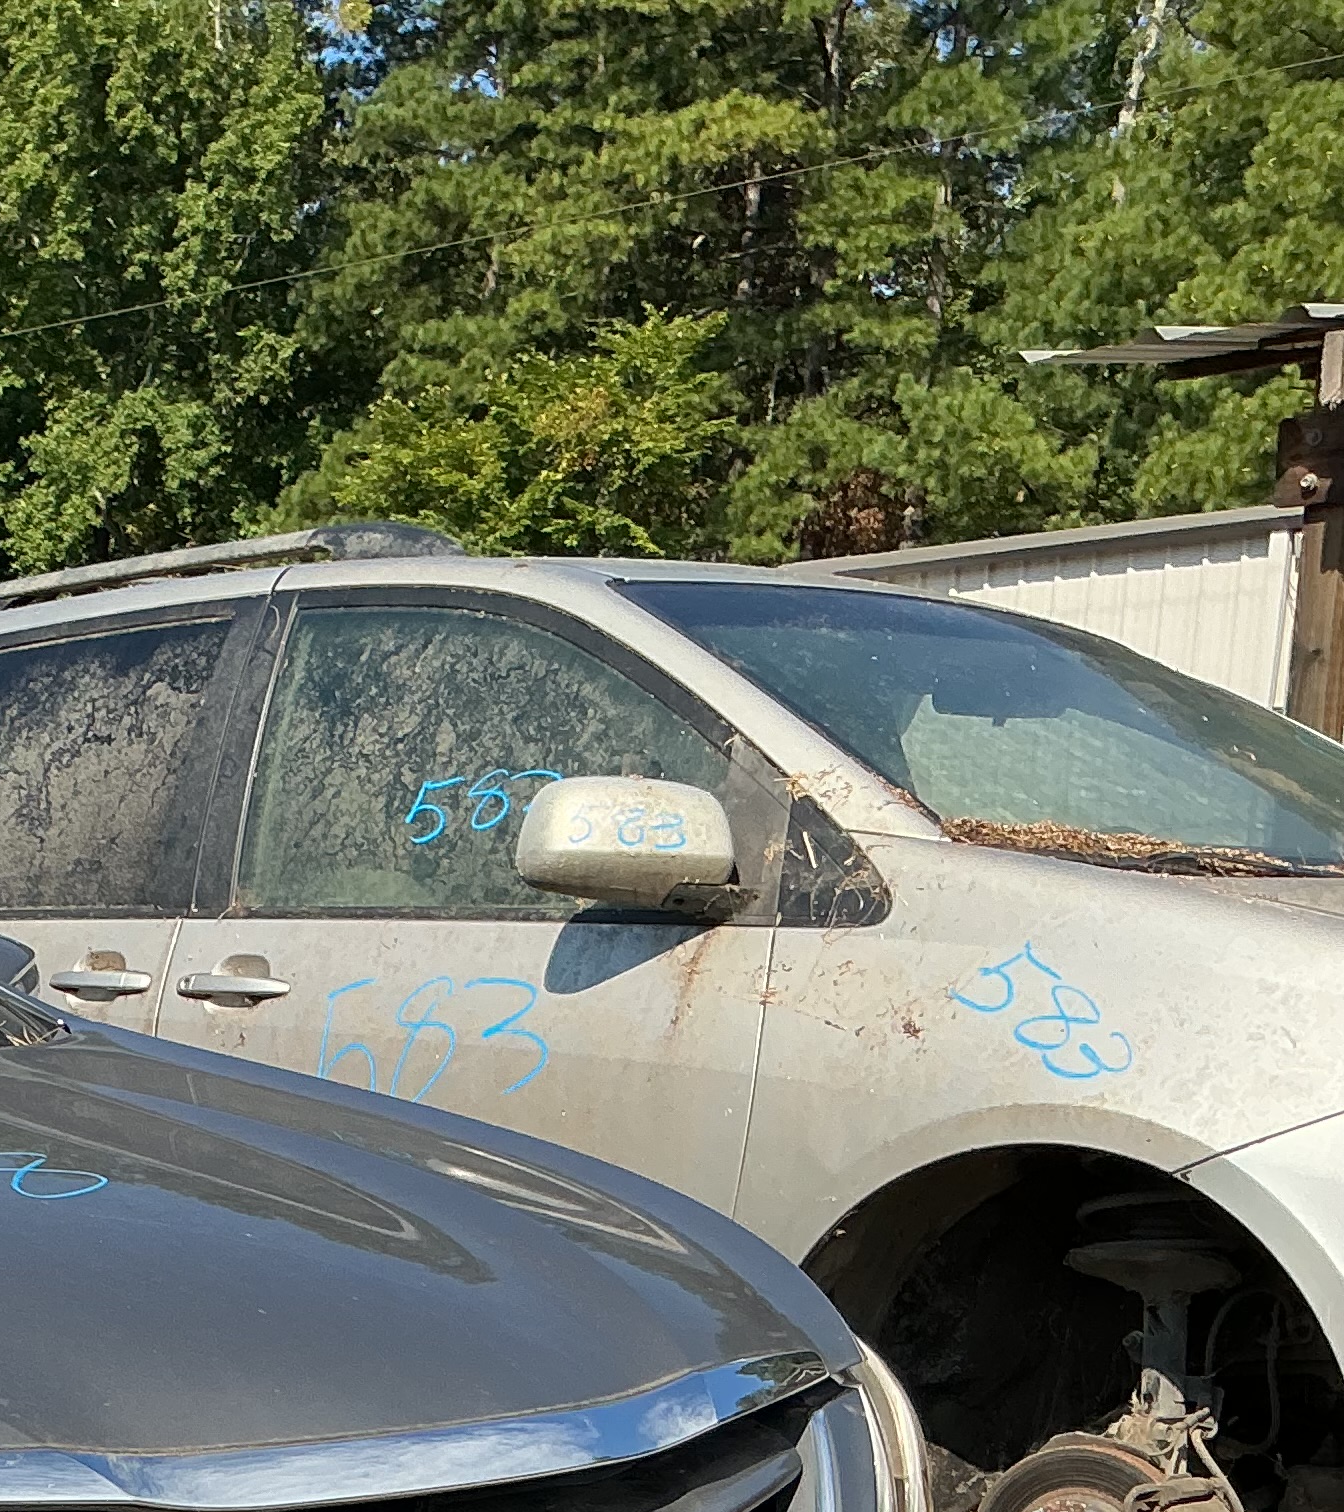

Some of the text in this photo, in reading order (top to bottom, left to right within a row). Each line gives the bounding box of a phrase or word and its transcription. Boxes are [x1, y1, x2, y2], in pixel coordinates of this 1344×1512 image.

[567, 807, 687, 851] 583
[317, 976, 550, 1103] 583
[948, 939, 1133, 1079] 583
